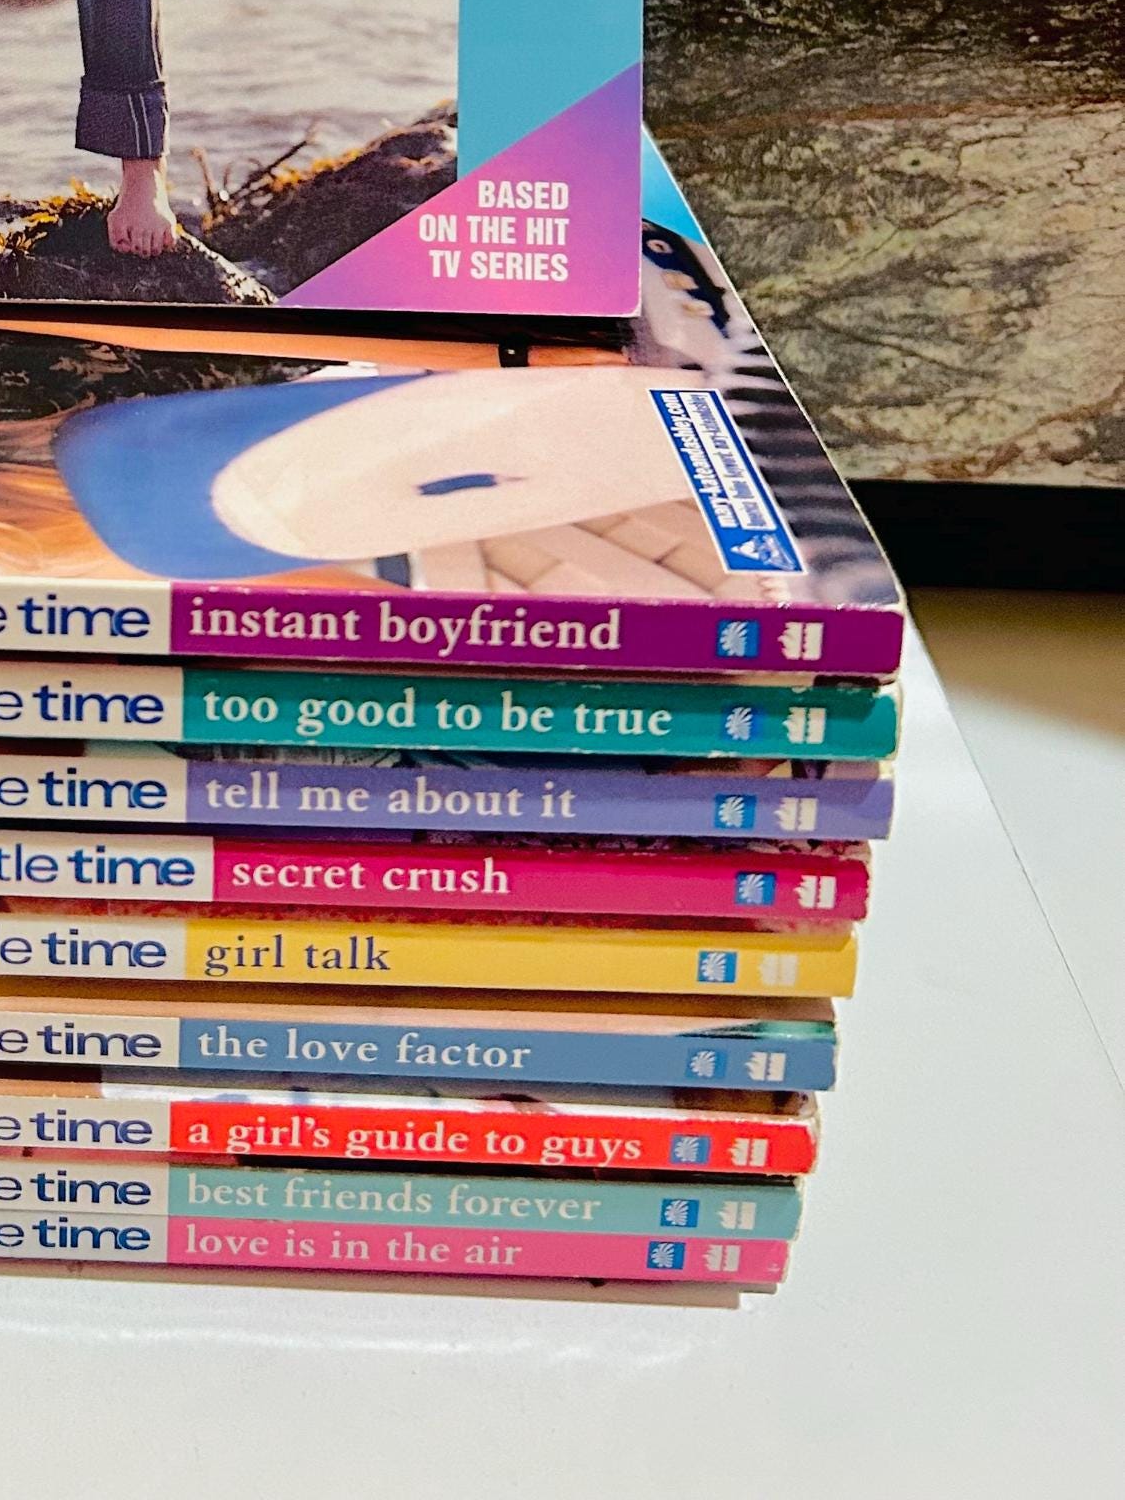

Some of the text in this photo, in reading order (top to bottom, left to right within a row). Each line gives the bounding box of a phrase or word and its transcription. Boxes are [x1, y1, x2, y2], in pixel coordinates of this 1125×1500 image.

[478, 180, 569, 210] BASED
[418, 214, 570, 245] ON THE HIT
[429, 249, 569, 281] TV SERIES
[18, 593, 150, 638] time
[189, 596, 360, 642] instant
[379, 603, 622, 657] boyfriend
[33, 681, 164, 724] time
[204, 691, 279, 723] too
[295, 688, 415, 737] good
[437, 696, 483, 731] to
[501, 691, 555, 733] be
[574, 699, 672, 736] true
[38, 767, 167, 810] time
[205, 771, 279, 810] tell
[298, 785, 370, 813] me
[387, 775, 523, 818] about
[541, 781, 576, 818] it
[67, 845, 195, 887] time
[231, 858, 364, 891] secret
[382, 859, 509, 895] crush
[42, 925, 167, 969] time
[205, 936, 284, 977] girl
[304, 936, 390, 971] talk
[37, 1016, 161, 1059] time
[198, 1027, 269, 1059] the
[285, 1028, 378, 1064] love
[396, 1032, 531, 1070] factor
[29, 1108, 153, 1145] time
[187, 1123, 210, 1145] a
[226, 1116, 331, 1155] girl’s
[345, 1118, 468, 1158] guide
[485, 1128, 525, 1156] to
[540, 1131, 643, 1167] guys
[31, 1166, 152, 1206] time
[187, 1174, 270, 1207] best
[284, 1175, 433, 1216] friends
[447, 1184, 601, 1222] forever
[32, 1215, 151, 1252] time
[185, 1225, 270, 1257] love
[285, 1229, 315, 1259] is
[330, 1229, 370, 1260] in
[386, 1231, 449, 1264] the
[465, 1236, 522, 1266] air
